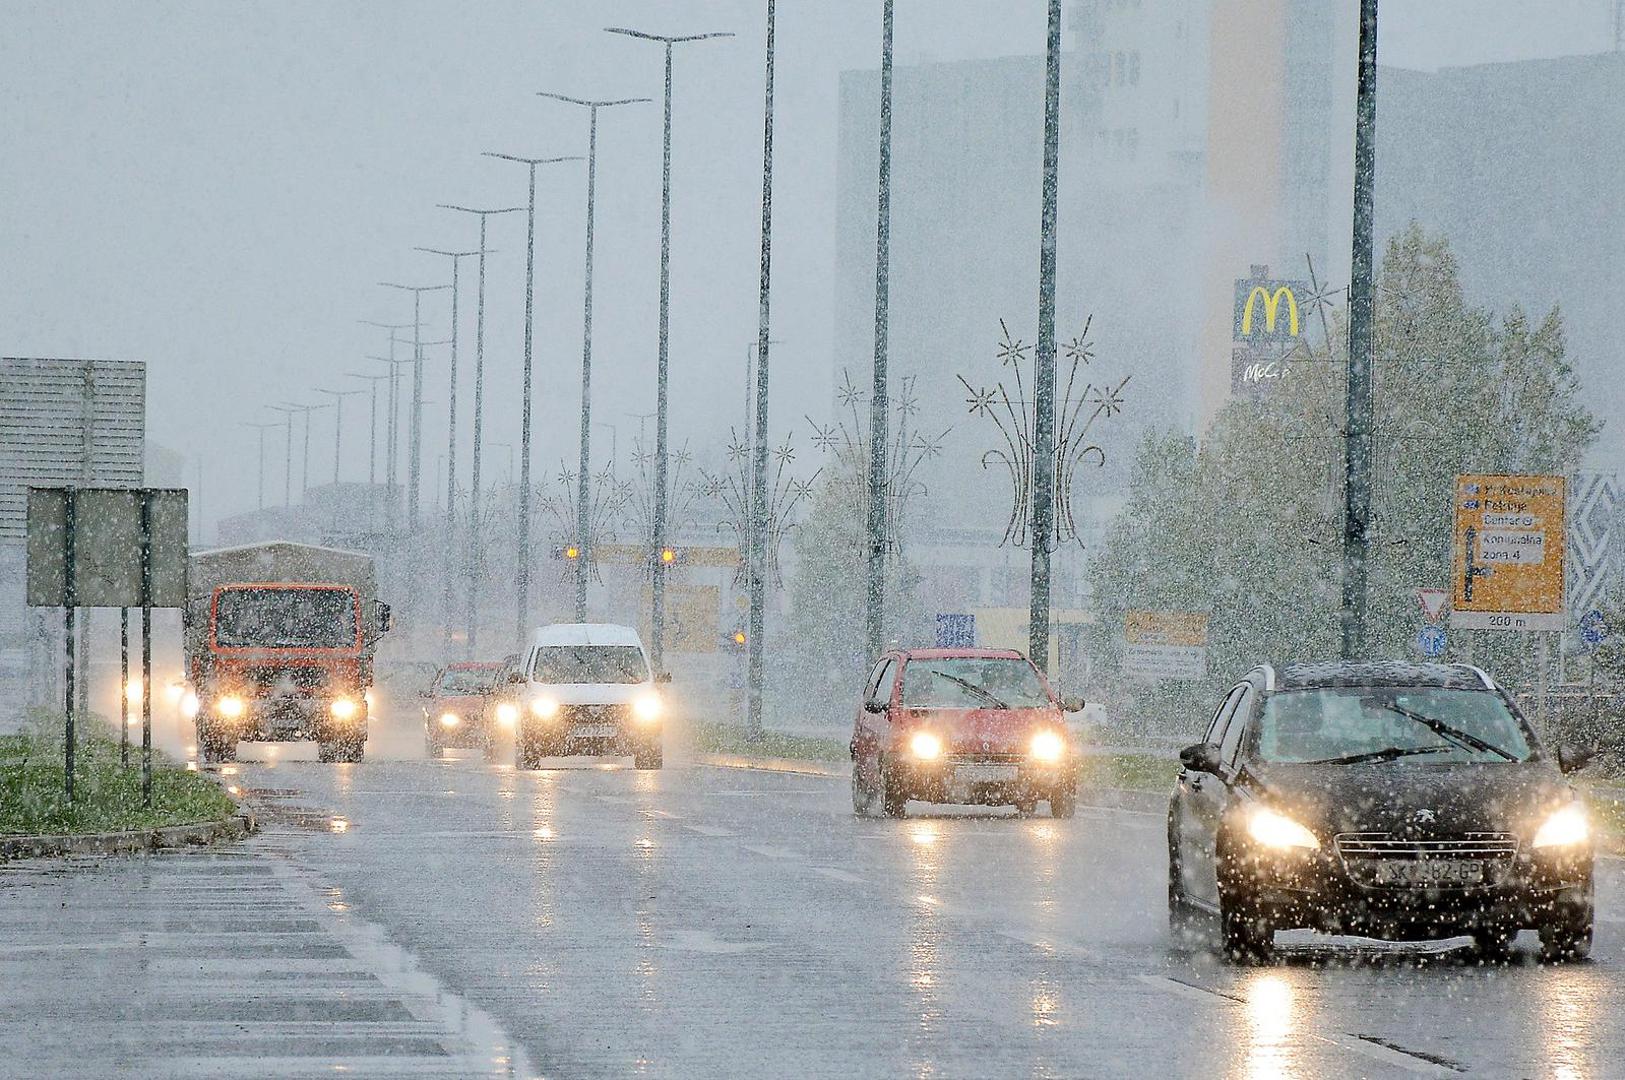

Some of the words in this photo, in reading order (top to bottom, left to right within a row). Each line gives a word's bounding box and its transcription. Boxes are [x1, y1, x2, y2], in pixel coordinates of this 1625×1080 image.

[1483, 551, 1508, 560] zona
[1489, 616, 1511, 627] 200
[1516, 617, 1526, 627] m
